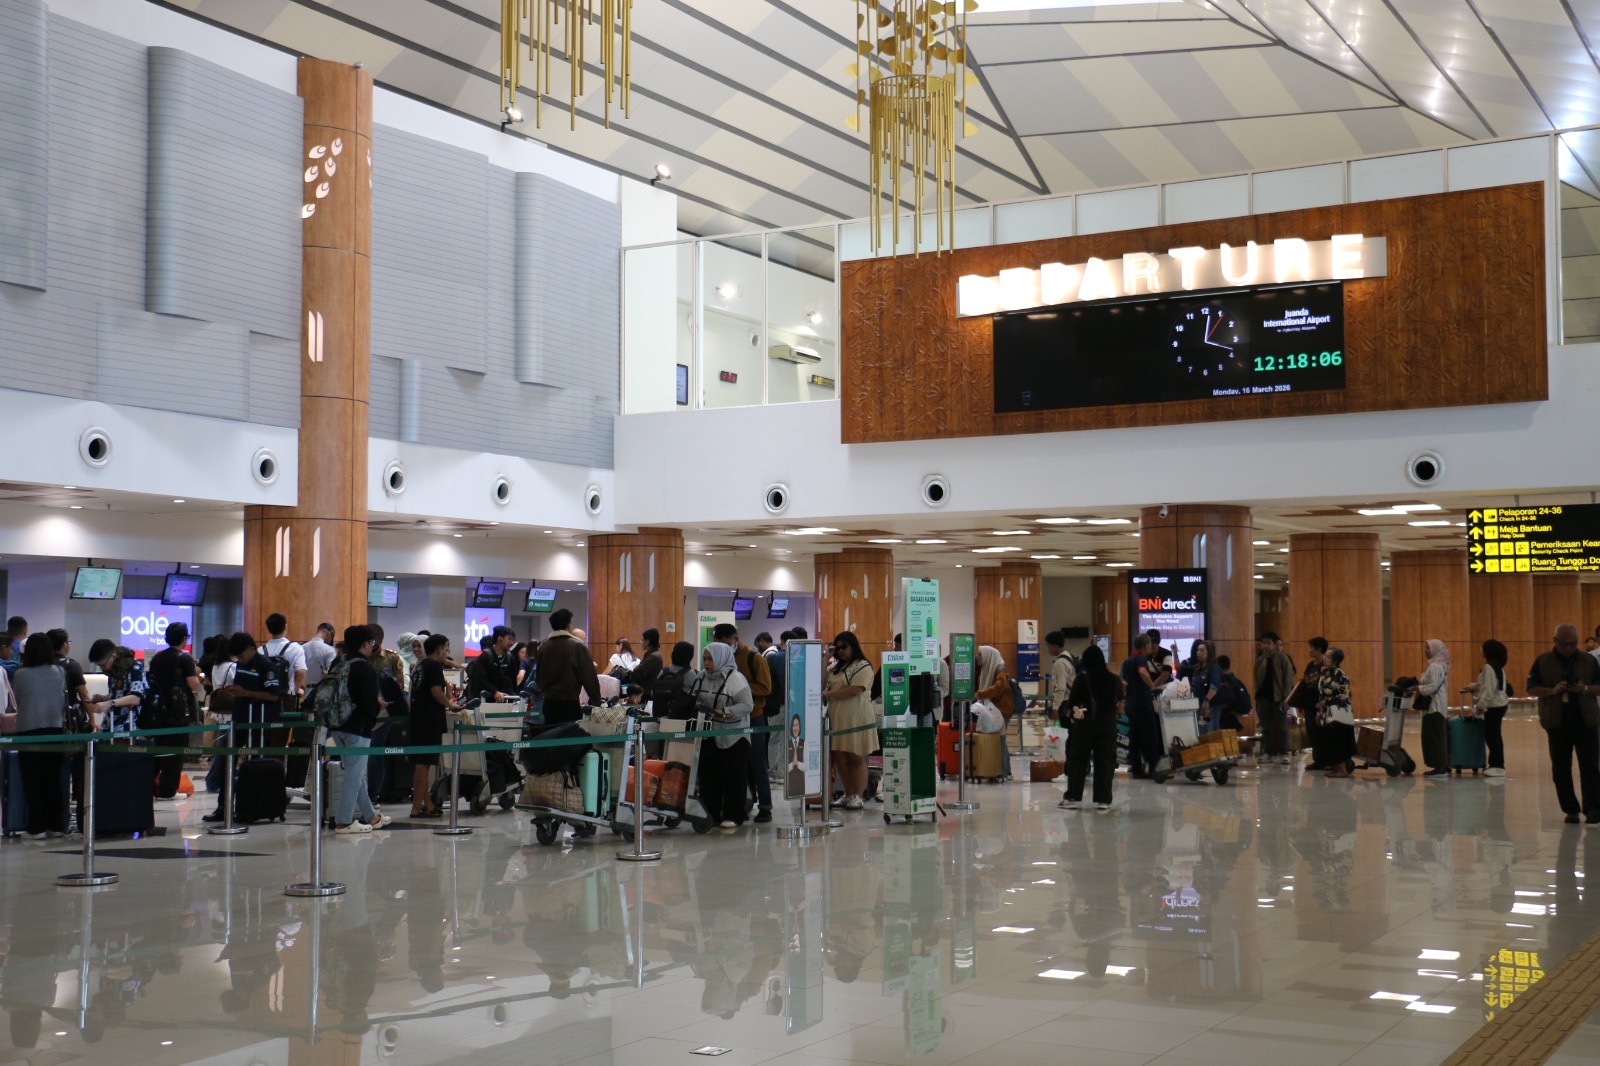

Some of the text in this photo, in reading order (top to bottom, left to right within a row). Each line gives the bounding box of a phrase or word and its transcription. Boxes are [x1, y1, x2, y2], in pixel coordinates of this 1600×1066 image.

[958, 233, 1364, 317] DEPARTURE
[1200, 307, 1210, 315] 12
[1218, 310, 1223, 318] 1
[1284, 308, 1309, 319] Juanda
[1264, 315, 1330, 328] International Airport
[1254, 351, 1342, 372] 12:18:06
[1252, 386, 1273, 394] March
[1499, 508, 1537, 517] Pelaporan
[1500, 526, 1518, 534] Meja
[1532, 558, 1556, 566] Ruang
[1558, 558, 1588, 566] Tunggu
